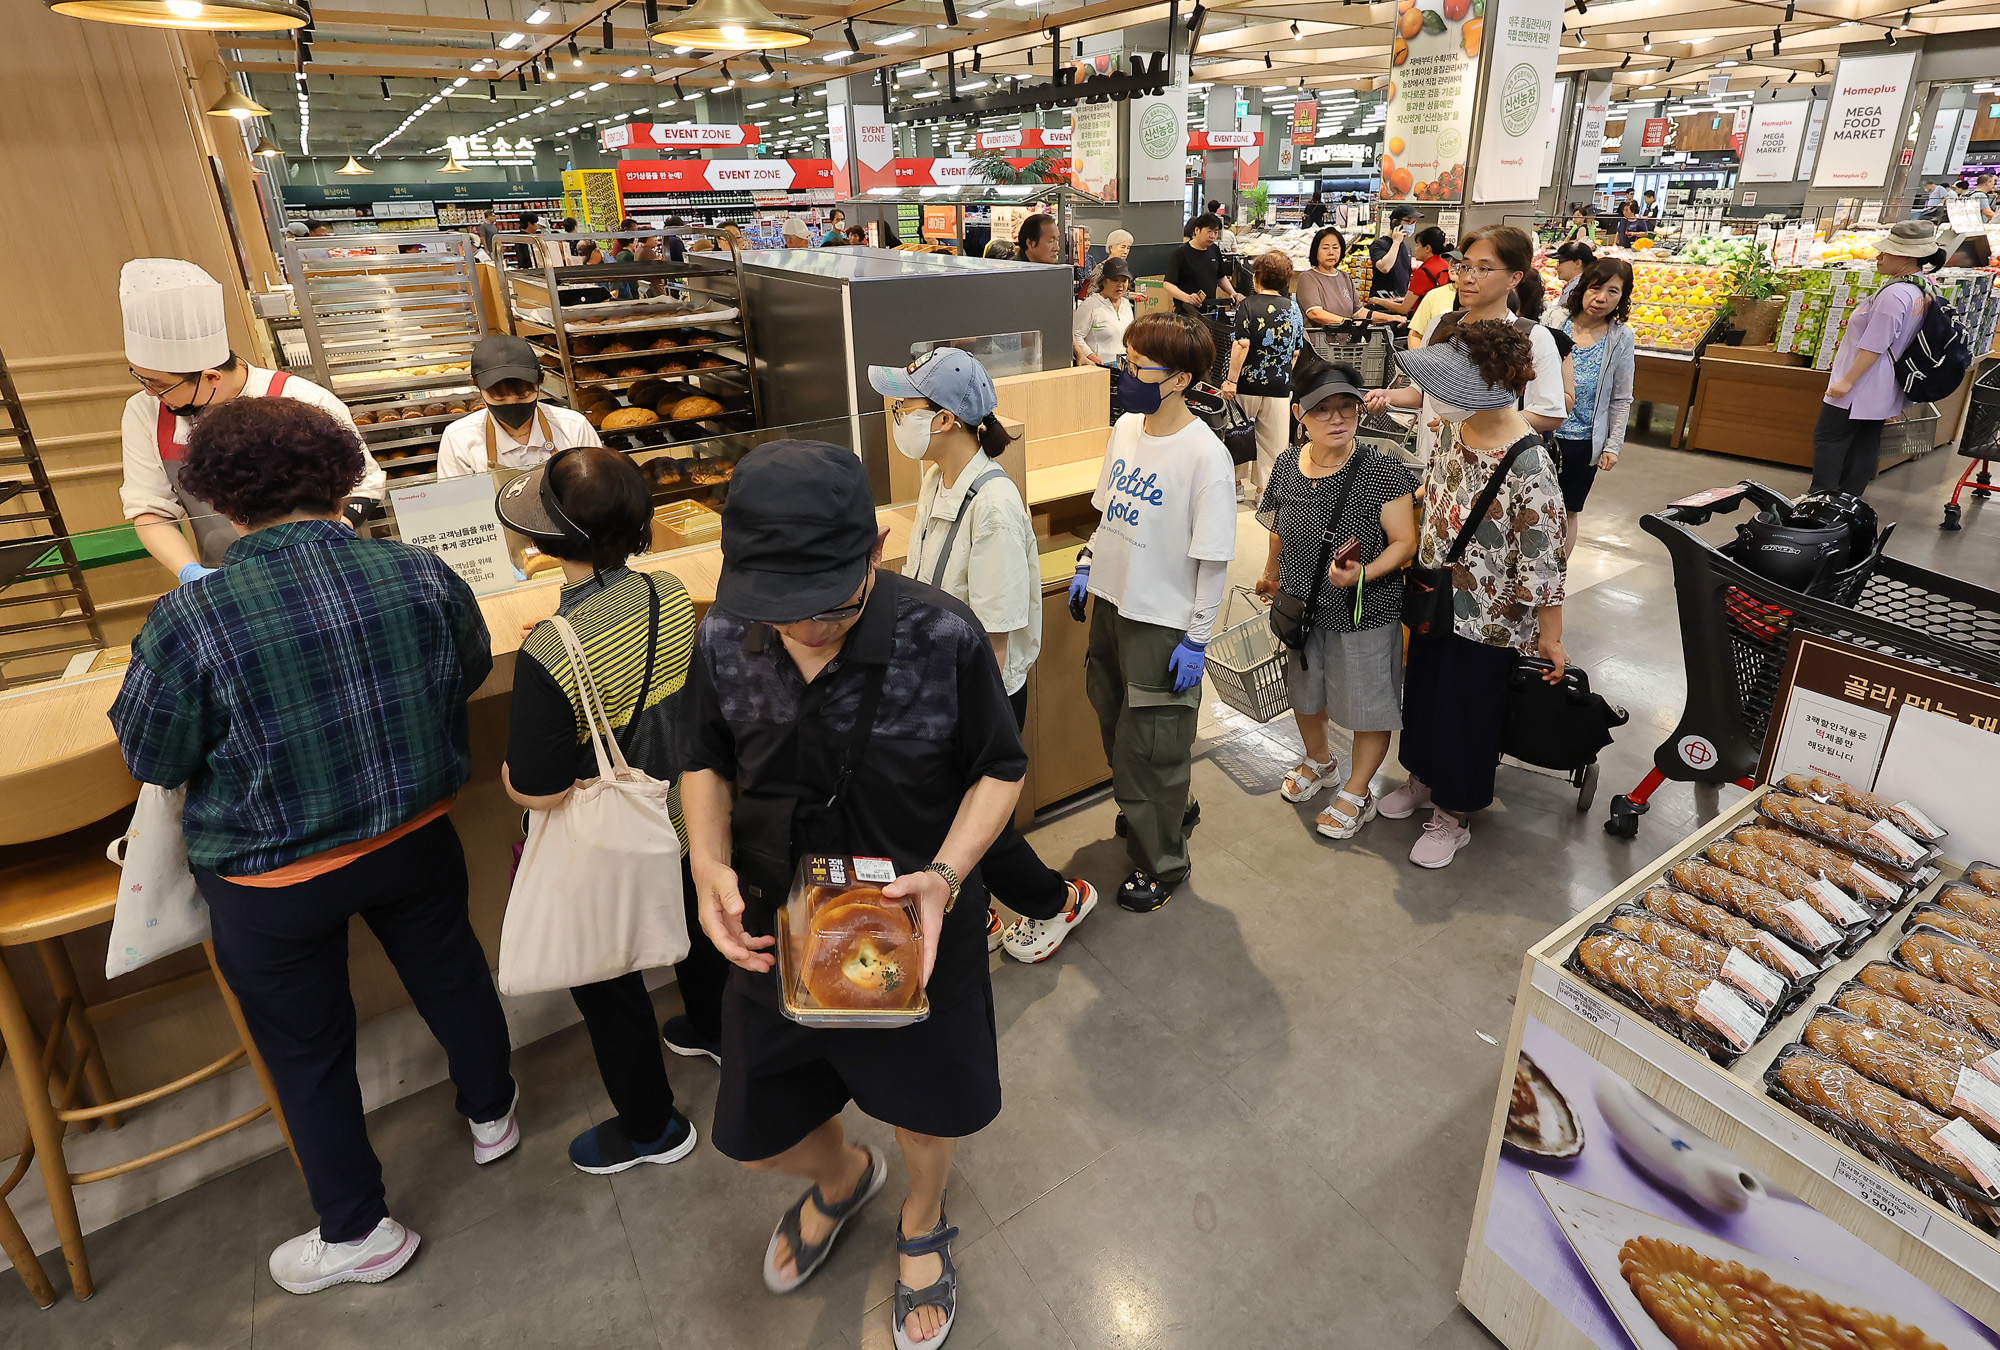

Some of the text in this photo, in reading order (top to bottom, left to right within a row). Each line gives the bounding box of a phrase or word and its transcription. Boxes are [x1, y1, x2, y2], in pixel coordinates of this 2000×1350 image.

[1403, 79, 1424, 88] 농장에서
[1402, 90, 1426, 99] 까다로운
[1843, 85, 1896, 96] Homeplus
[1505, 87, 1536, 113] 신선농장
[1301, 109, 1309, 119] AI
[1587, 105, 1605, 114] Homeplus
[1846, 107, 1882, 117] MEGA
[1586, 121, 1600, 129] MEGA
[1844, 118, 1880, 128] FOOD
[665, 129, 731, 139] EVENT ZONE
[862, 126, 885, 134] EVENT
[1145, 121, 1173, 141] 신선농장
[1834, 129, 1885, 140] MARKET
[987, 135, 1016, 144] EVENT ZONE
[1581, 139, 1600, 148] MARKET
[719, 170, 781, 179] EVENT ZONE
[942, 168, 965, 176] EVENT
[1107, 459, 1163, 506] Petite
[1107, 495, 1139, 526] joie
[412, 523, 495, 545] 이곳은 고객님들을 위한
[441, 541, 457, 551] 휴게
[459, 533, 497, 548] 공간입니다
[478, 557, 493, 565] 위해
[463, 572, 494, 583] 드립니다
[1844, 674, 1897, 709] 골라
[1805, 715, 1867, 741] 3팩할인적용은
[1816, 728, 1854, 748] 떡제품만
[1808, 740, 1854, 762] 해당됩니다
[1574, 1004, 1597, 1022] 9,900
[1861, 1191, 1895, 1217] 9,900
